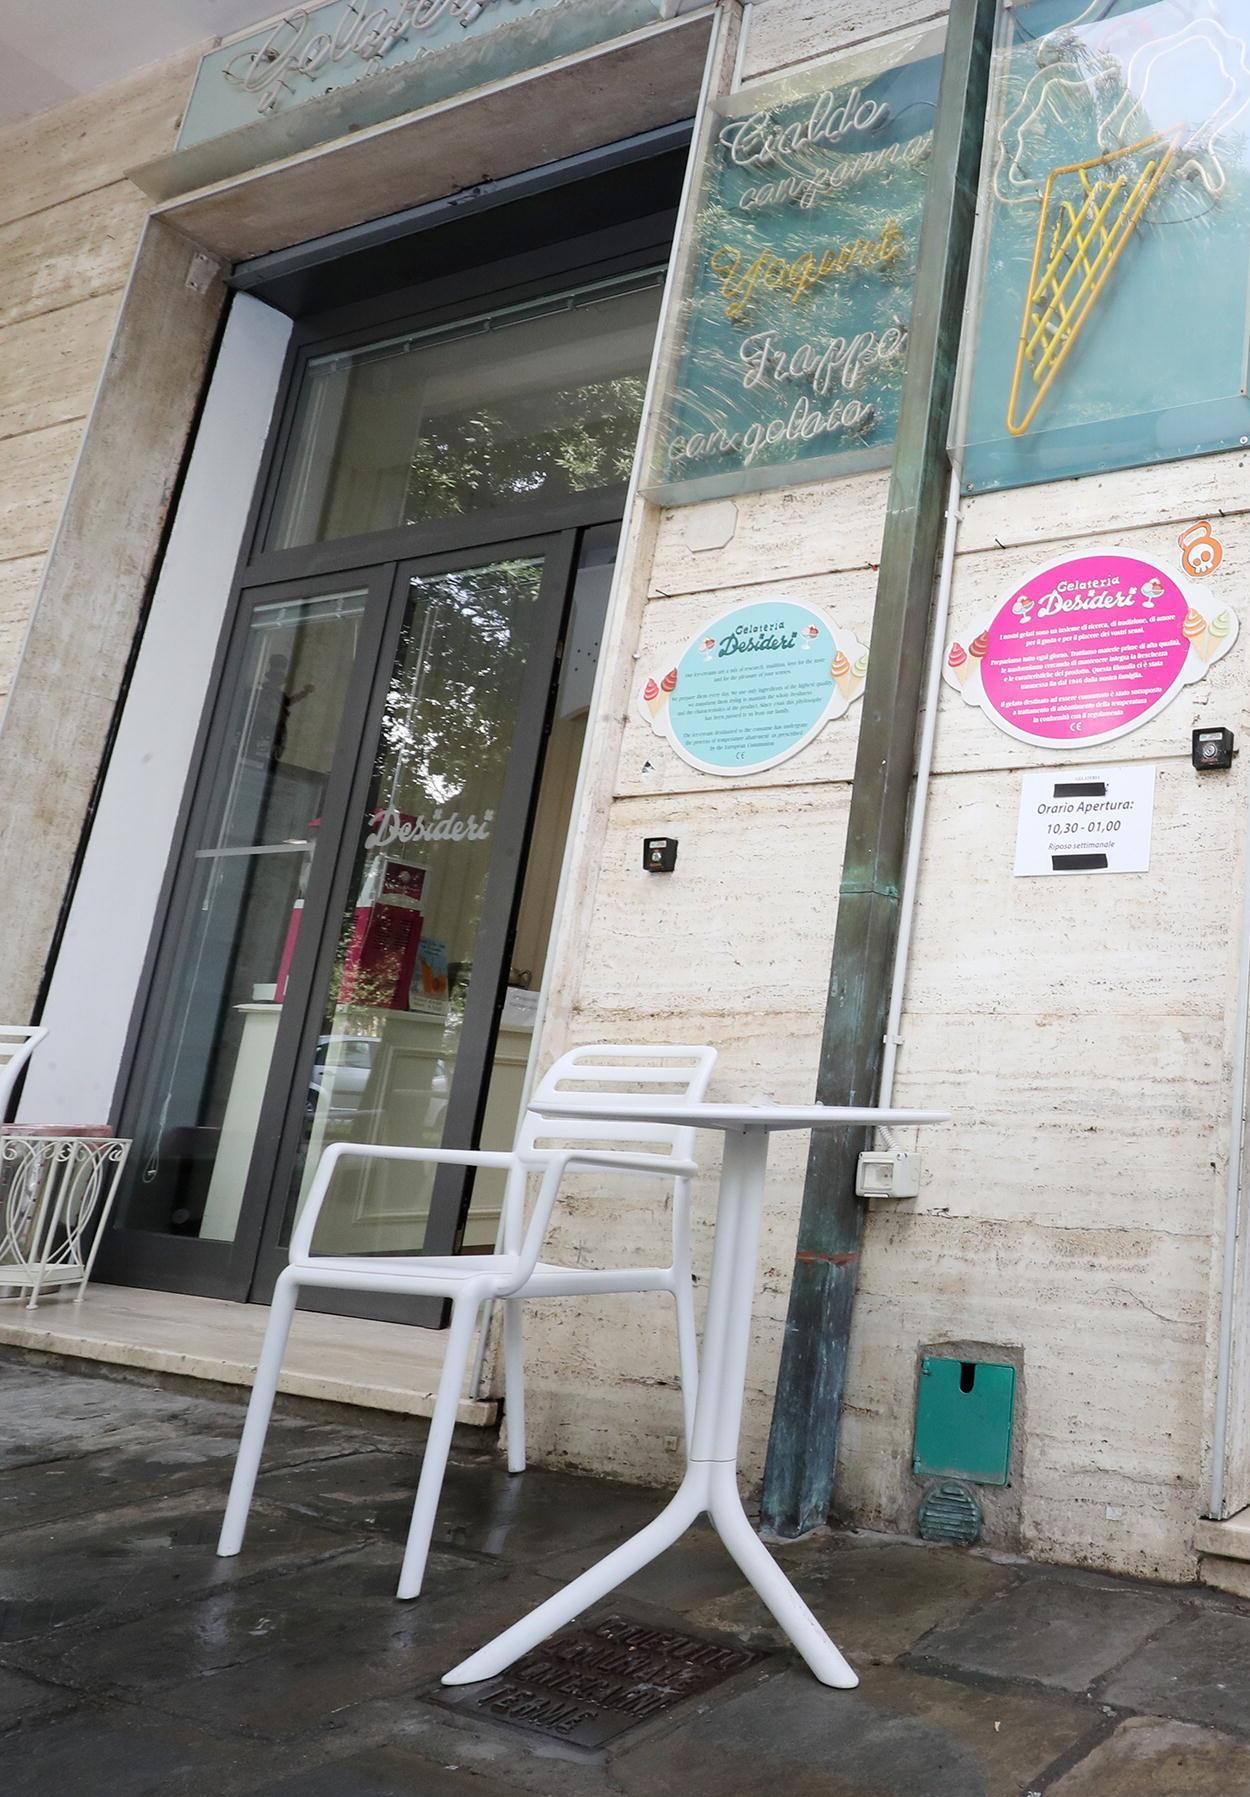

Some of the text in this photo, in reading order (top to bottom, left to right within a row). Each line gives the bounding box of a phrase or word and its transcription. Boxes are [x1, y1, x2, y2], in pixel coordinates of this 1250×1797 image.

[710, 217, 904, 317] Yogurt
[743, 396, 873, 466] gelato
[1056, 575, 1120, 592] Gelateria
[1037, 587, 1138, 618] Desideri
[735, 622, 784, 635] Gelateria
[718, 632, 798, 657] Desideri
[1037, 801, 1134, 814] Orario Apertura:
[364, 808, 495, 849] Desideri
[1048, 823, 1079, 835] 10,30
[1087, 820, 1122, 833] 01,00
[1048, 840, 1116, 852] Riposo settimanale
[477, 1684, 599, 1735] TERME
